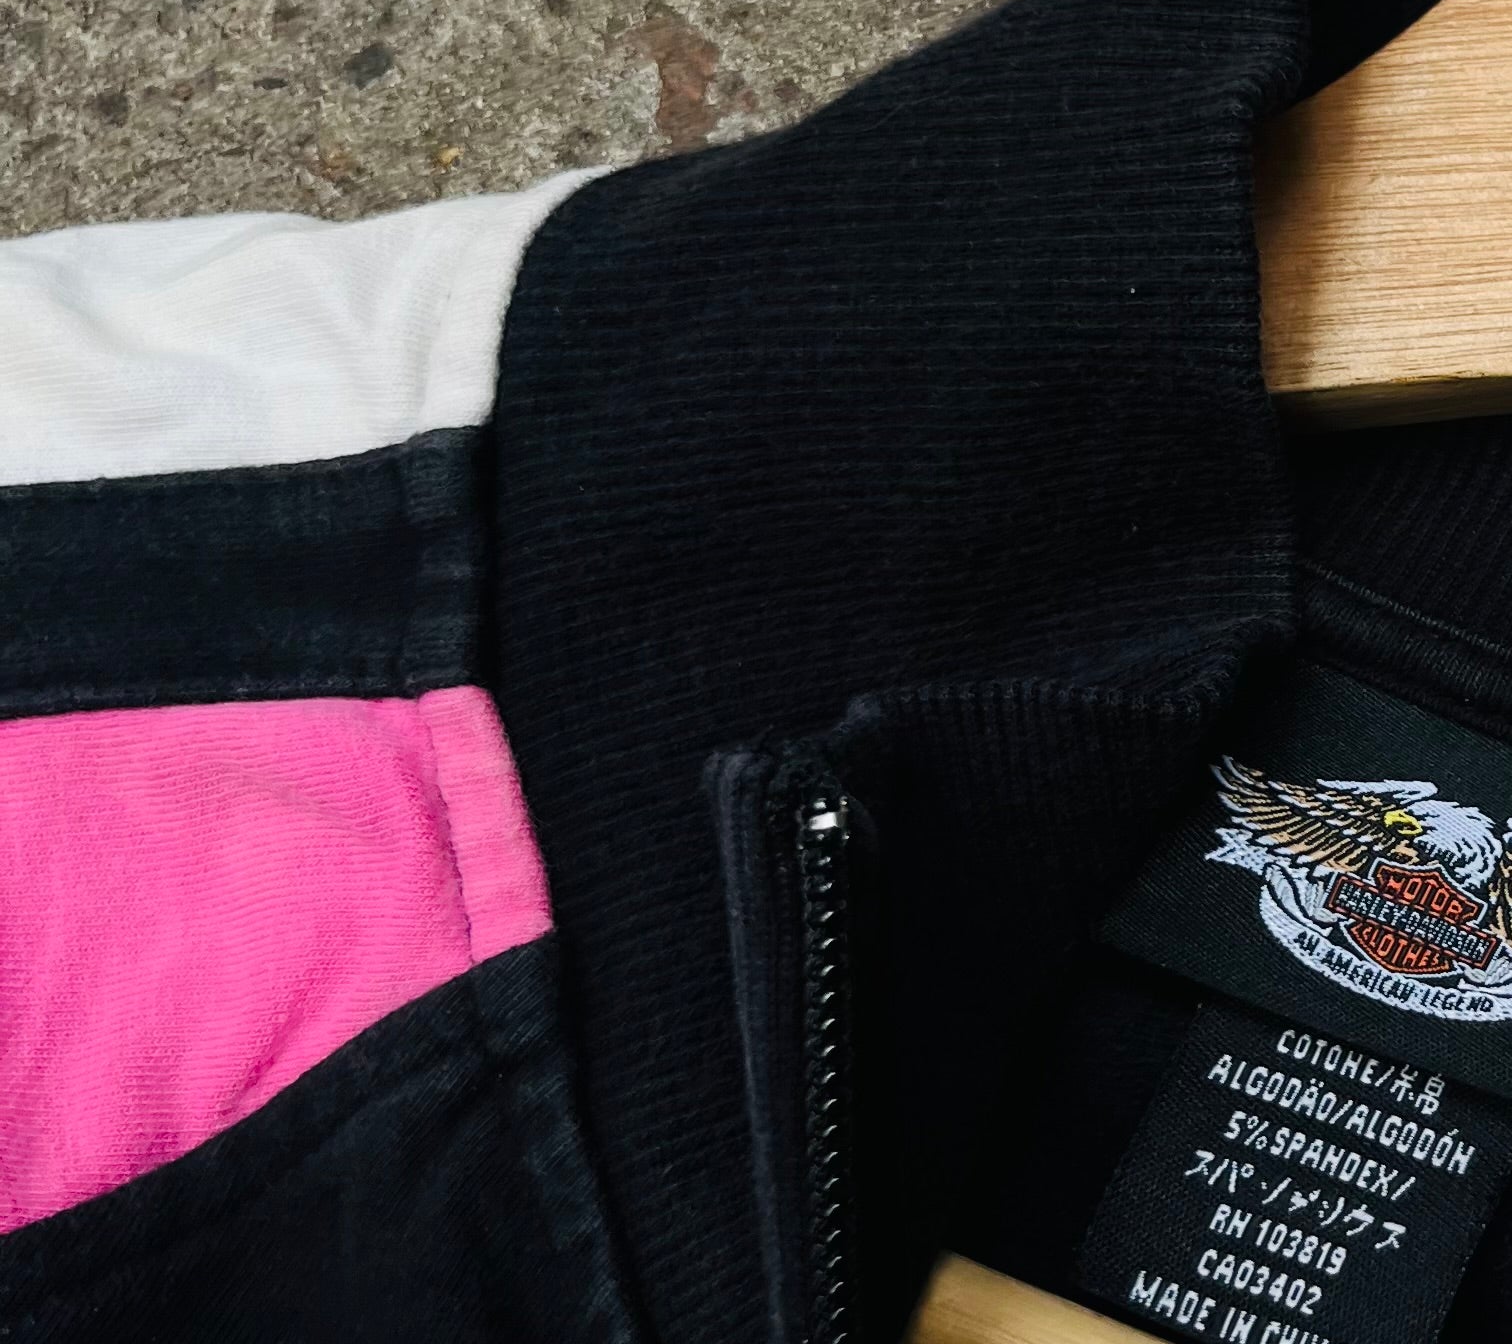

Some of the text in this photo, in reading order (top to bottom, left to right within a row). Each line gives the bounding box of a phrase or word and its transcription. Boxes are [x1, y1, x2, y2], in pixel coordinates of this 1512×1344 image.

[1336, 883, 1490, 961] HARLEY-DAVIDSON
[1387, 876, 1463, 920] MOTOR
[1363, 926, 1440, 967] CLOTHES
[1322, 947, 1415, 1003] AMERICAN
[1420, 987, 1494, 1012] LEGEND
[1256, 1218, 1348, 1275] 103819
[1129, 1270, 1217, 1331] MADE
[1197, 1249, 1323, 1315] CA03402
